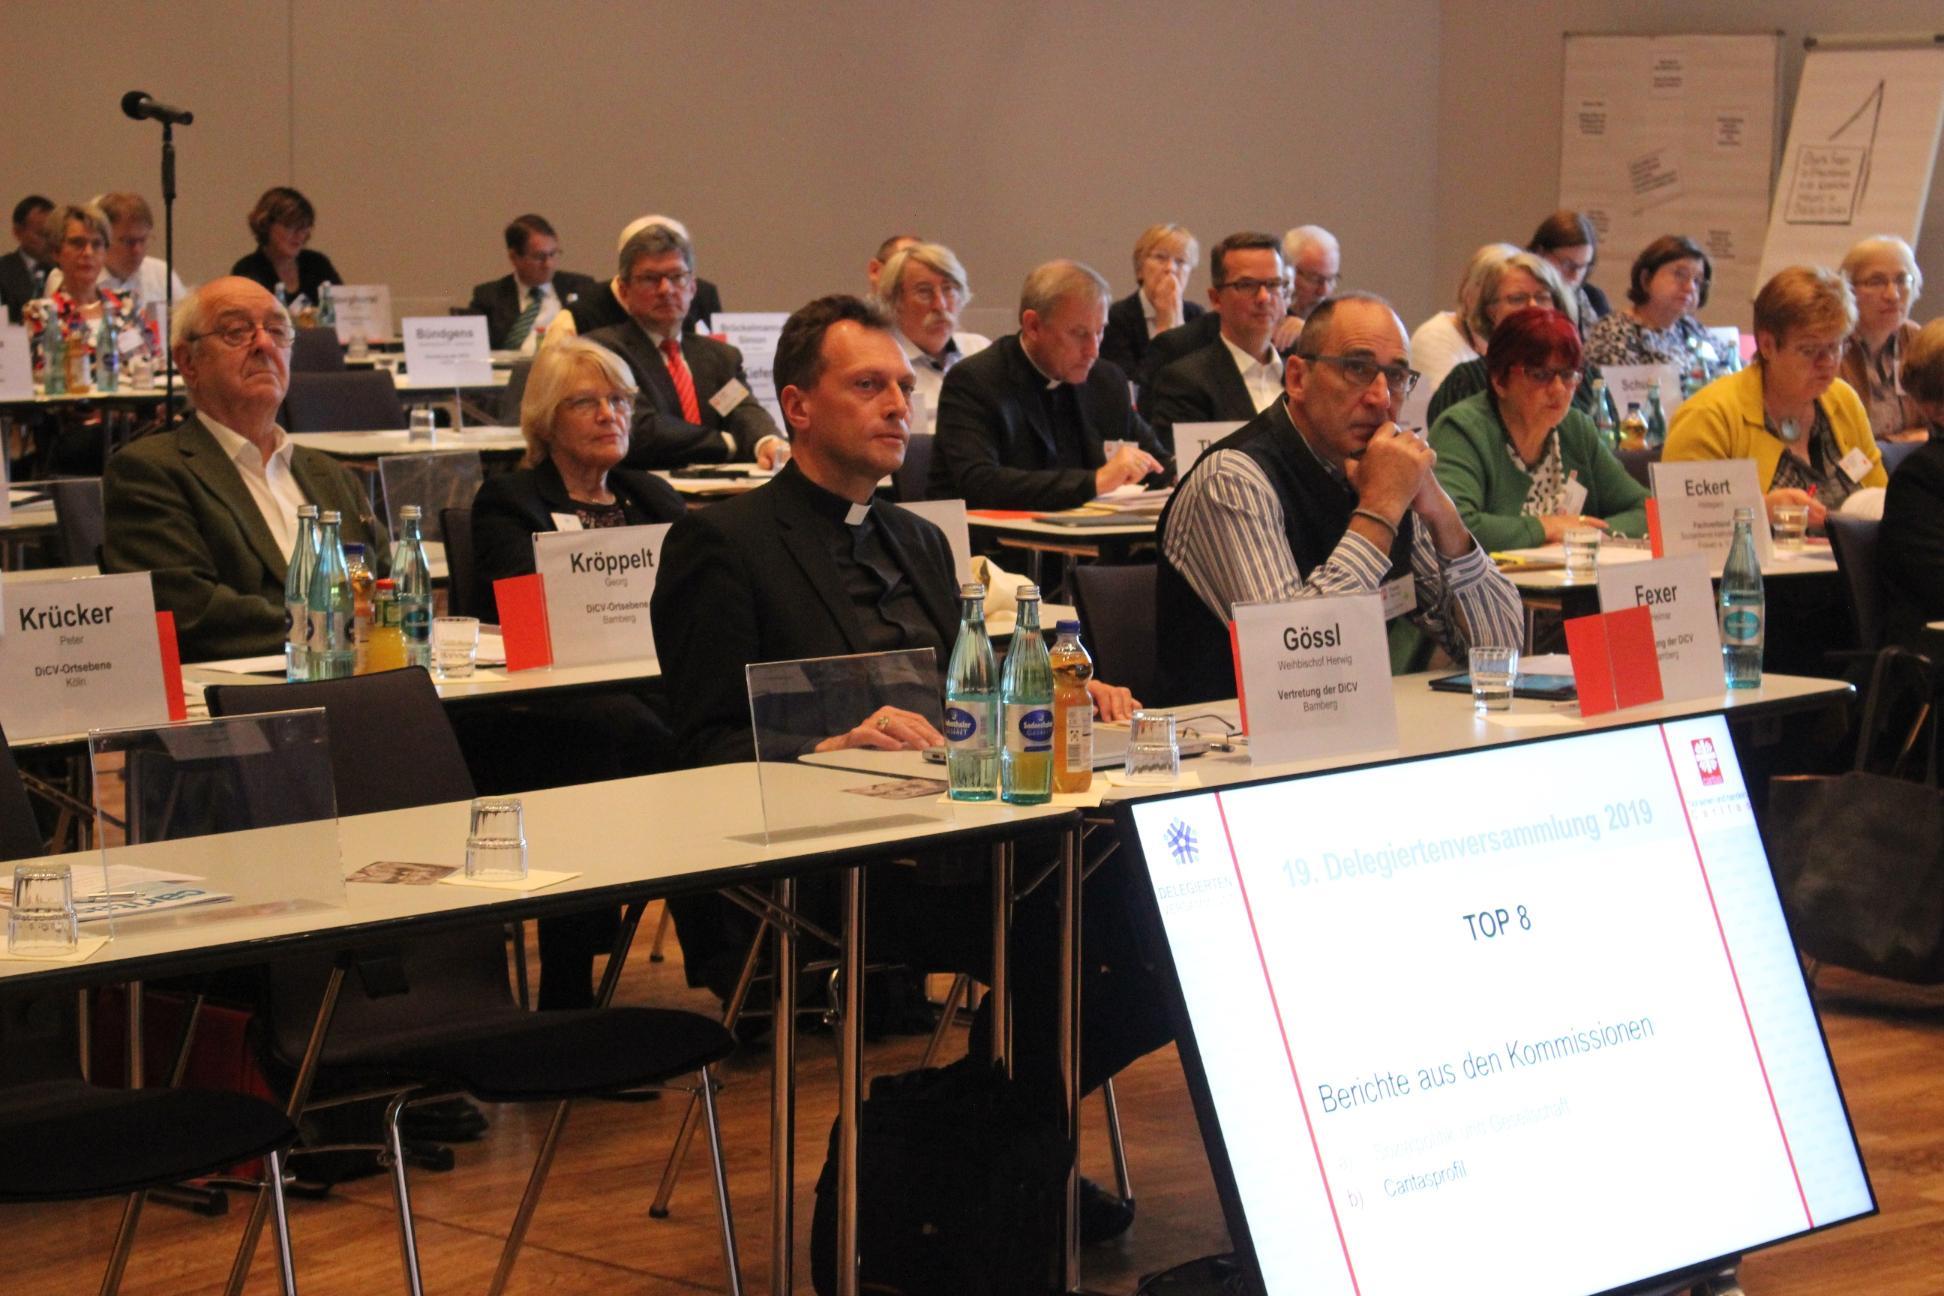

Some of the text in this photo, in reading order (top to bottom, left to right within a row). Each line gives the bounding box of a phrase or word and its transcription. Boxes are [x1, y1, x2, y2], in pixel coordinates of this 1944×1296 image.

[416, 328, 474, 341] Bündgens
[1685, 479, 1731, 496] Eckert
[570, 547, 654, 576] Kröppelt
[605, 578, 628, 587] Georg
[1635, 585, 1677, 608] Fexer
[586, 601, 649, 613] DiCV-Ortsebene
[19, 603, 114, 631] Krücker
[603, 615, 636, 624] Bamberg
[59, 635, 84, 646] Peter
[1283, 622, 1341, 651] Gössl
[35, 661, 112, 677] DiCV-Ortsebene
[1278, 655, 1353, 671] Weihbischof Herwig
[66, 677, 87, 688] Köln
[1278, 681, 1358, 700] Vertretung der DiCV
[1303, 700, 1338, 712] Bamberg
[1282, 799, 1654, 888] 19. Delegiertenversammlung 2019
[1158, 876, 1233, 900] DELEGIERTEN
[1462, 904, 1532, 941] TOP 8
[1318, 1015, 1656, 1114] Berichte aus den Kommissionen
[1346, 1160, 1468, 1210] b) Caritasprofil
